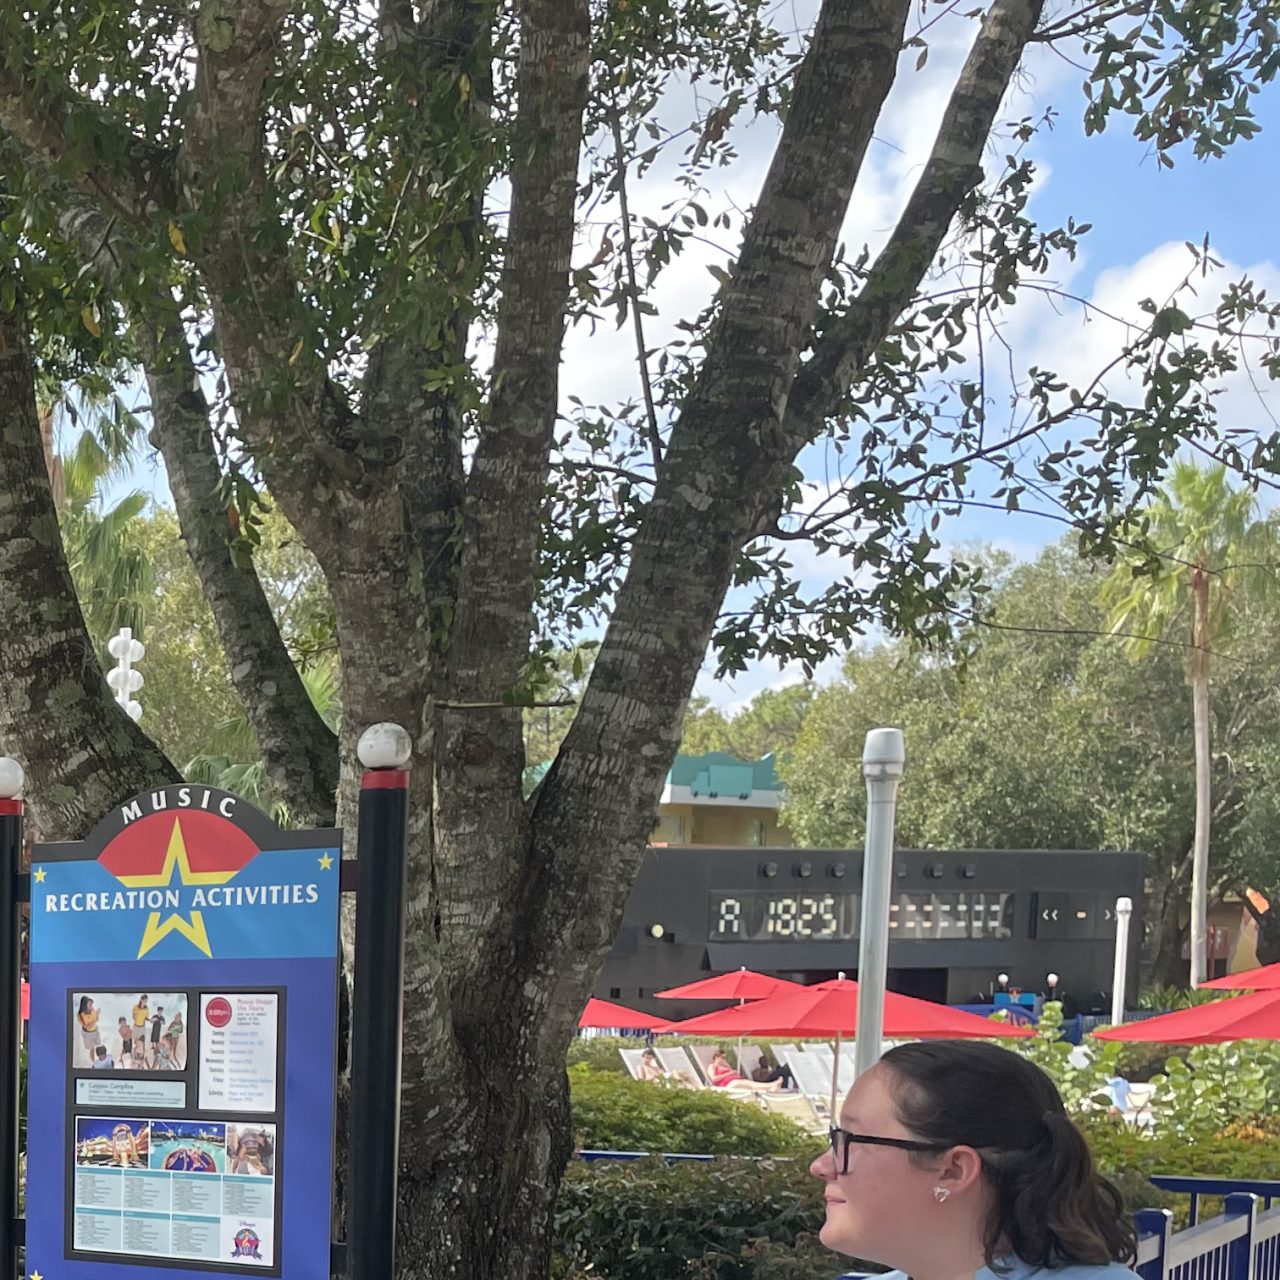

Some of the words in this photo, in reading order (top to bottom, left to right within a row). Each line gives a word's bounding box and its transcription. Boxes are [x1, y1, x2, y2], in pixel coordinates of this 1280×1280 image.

[121, 787, 236, 825] MUSIC
[45, 889, 180, 913] RECREATION
[191, 883, 320, 908] ACTIVITIES
